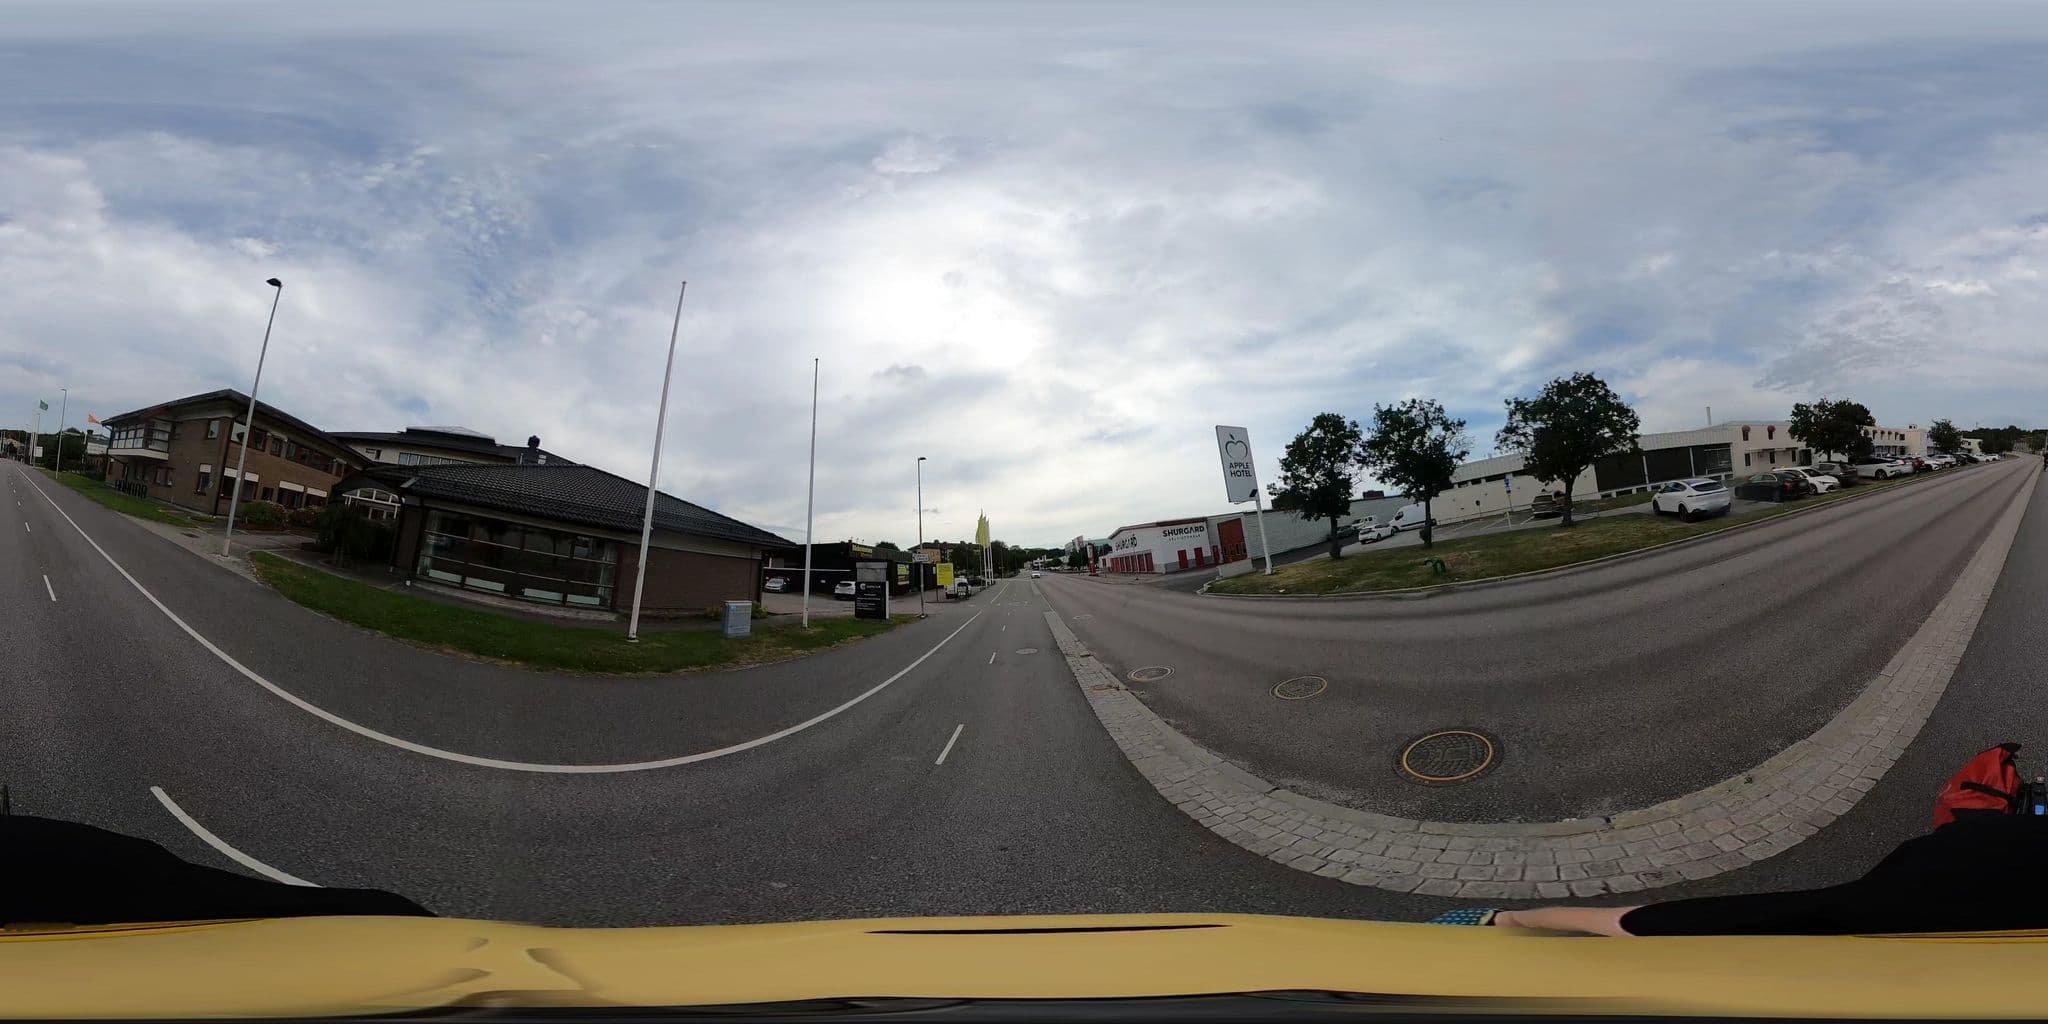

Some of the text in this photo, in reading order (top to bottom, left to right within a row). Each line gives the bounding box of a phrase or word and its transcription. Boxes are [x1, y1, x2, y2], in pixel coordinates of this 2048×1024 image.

[1229, 462, 1249, 470] APPLE
[1230, 469, 1252, 477] HOTEL
[1162, 525, 1205, 538] SHURGARD
